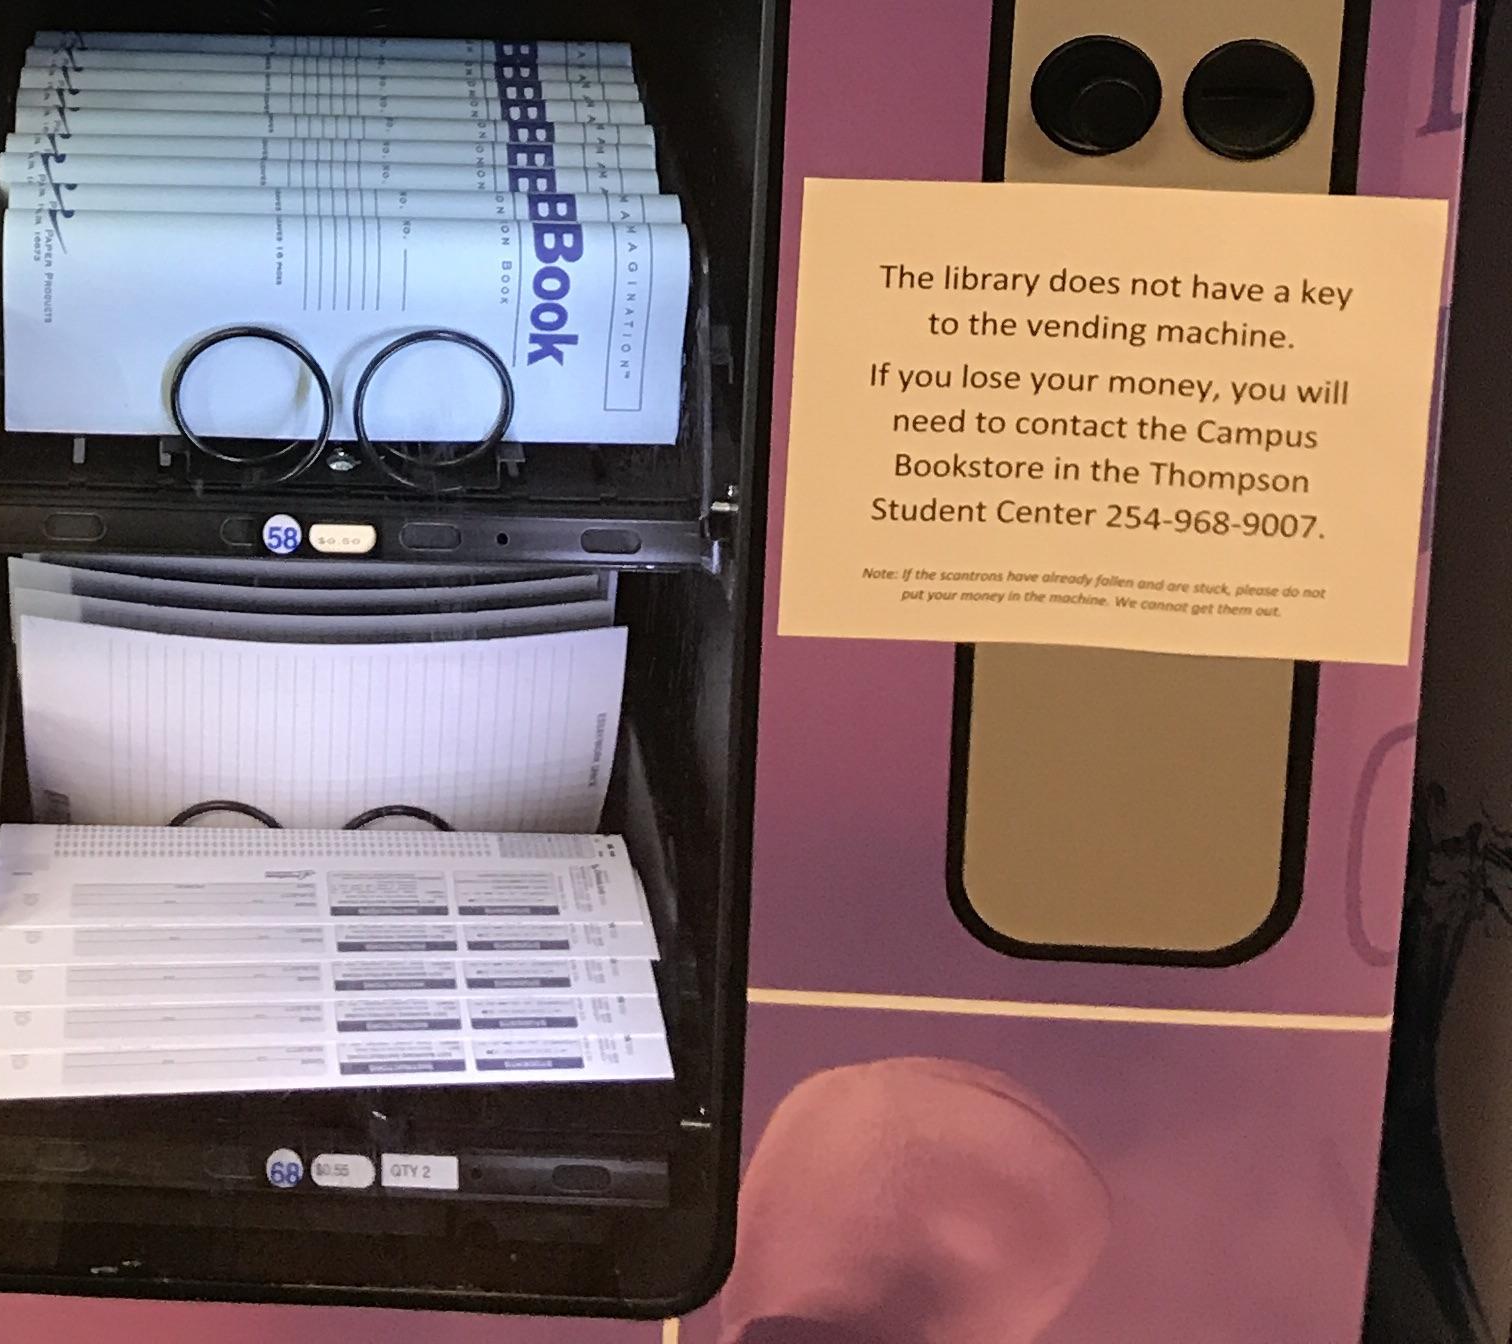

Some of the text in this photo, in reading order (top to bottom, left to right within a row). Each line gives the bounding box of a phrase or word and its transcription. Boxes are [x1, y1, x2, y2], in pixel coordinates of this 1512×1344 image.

[527, 223, 584, 368] Book
[880, 264, 1354, 311] The library does not have a key
[928, 311, 1294, 349] to the vending machine.
[870, 362, 1349, 405] If you lose your money, you will
[893, 408, 1318, 452] need to contact the Campus
[895, 453, 1309, 496] Bookstore in the Thompson
[267, 525, 298, 550] 58
[871, 497, 1325, 540] Student Center 254-968-9007.
